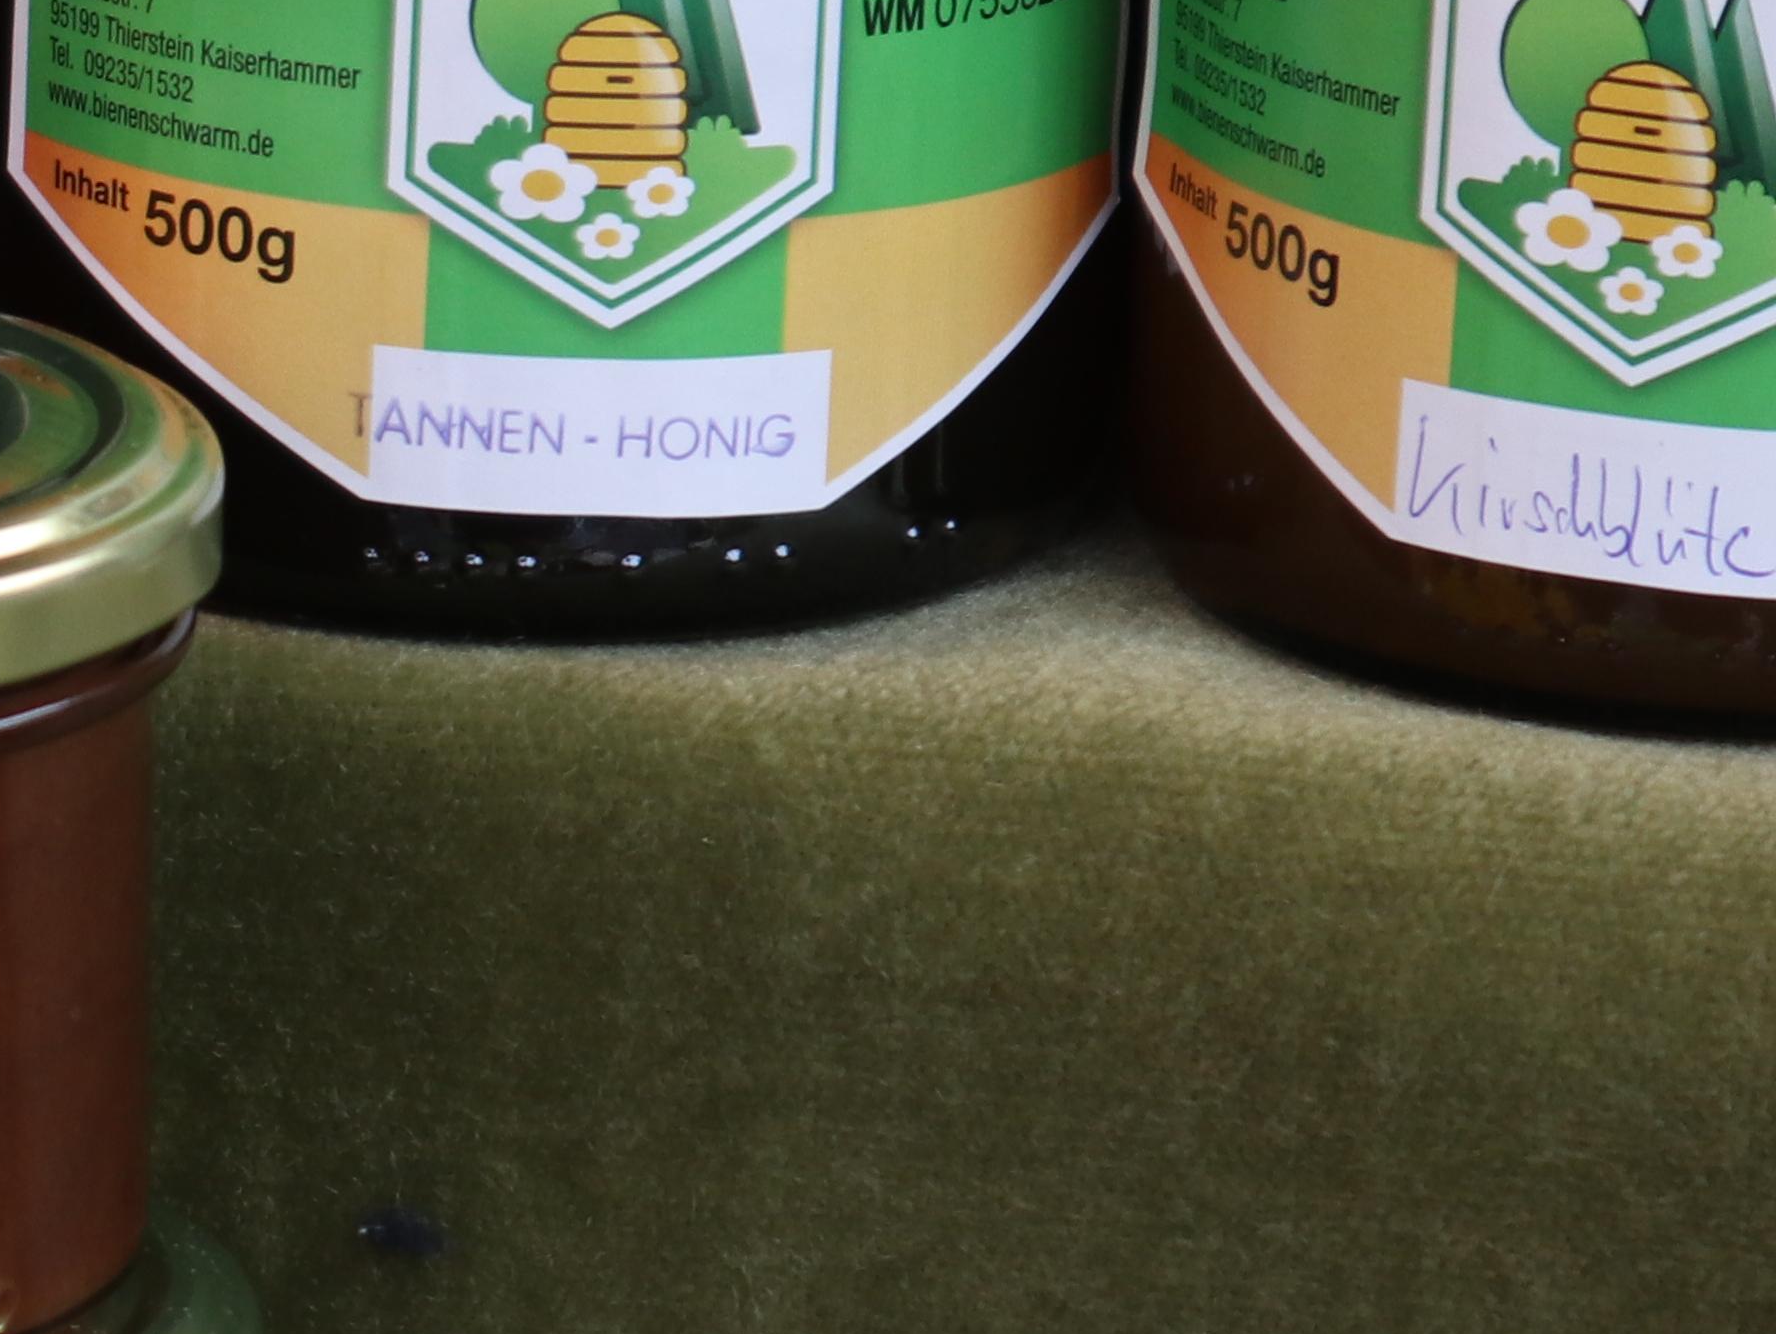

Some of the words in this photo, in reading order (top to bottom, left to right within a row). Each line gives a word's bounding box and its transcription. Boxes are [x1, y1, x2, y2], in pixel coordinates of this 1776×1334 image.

[49, 36, 75, 71] Tel.
[83, 49, 195, 104] 09235/1532
[105, 17, 195, 65] Thierstein
[200, 39, 361, 91] Kaiserhammer
[1271, 52, 1400, 116] Kaiserhammer
[48, 78, 276, 159] www.bienenschwarm.de
[54, 159, 131, 212] Inhalt
[144, 189, 296, 284] 500g
[1168, 162, 1218, 220] Inhalt
[1224, 200, 1340, 308] 500g
[348, 392, 567, 460] TANNEN
[617, 413, 797, 460] HONIG
